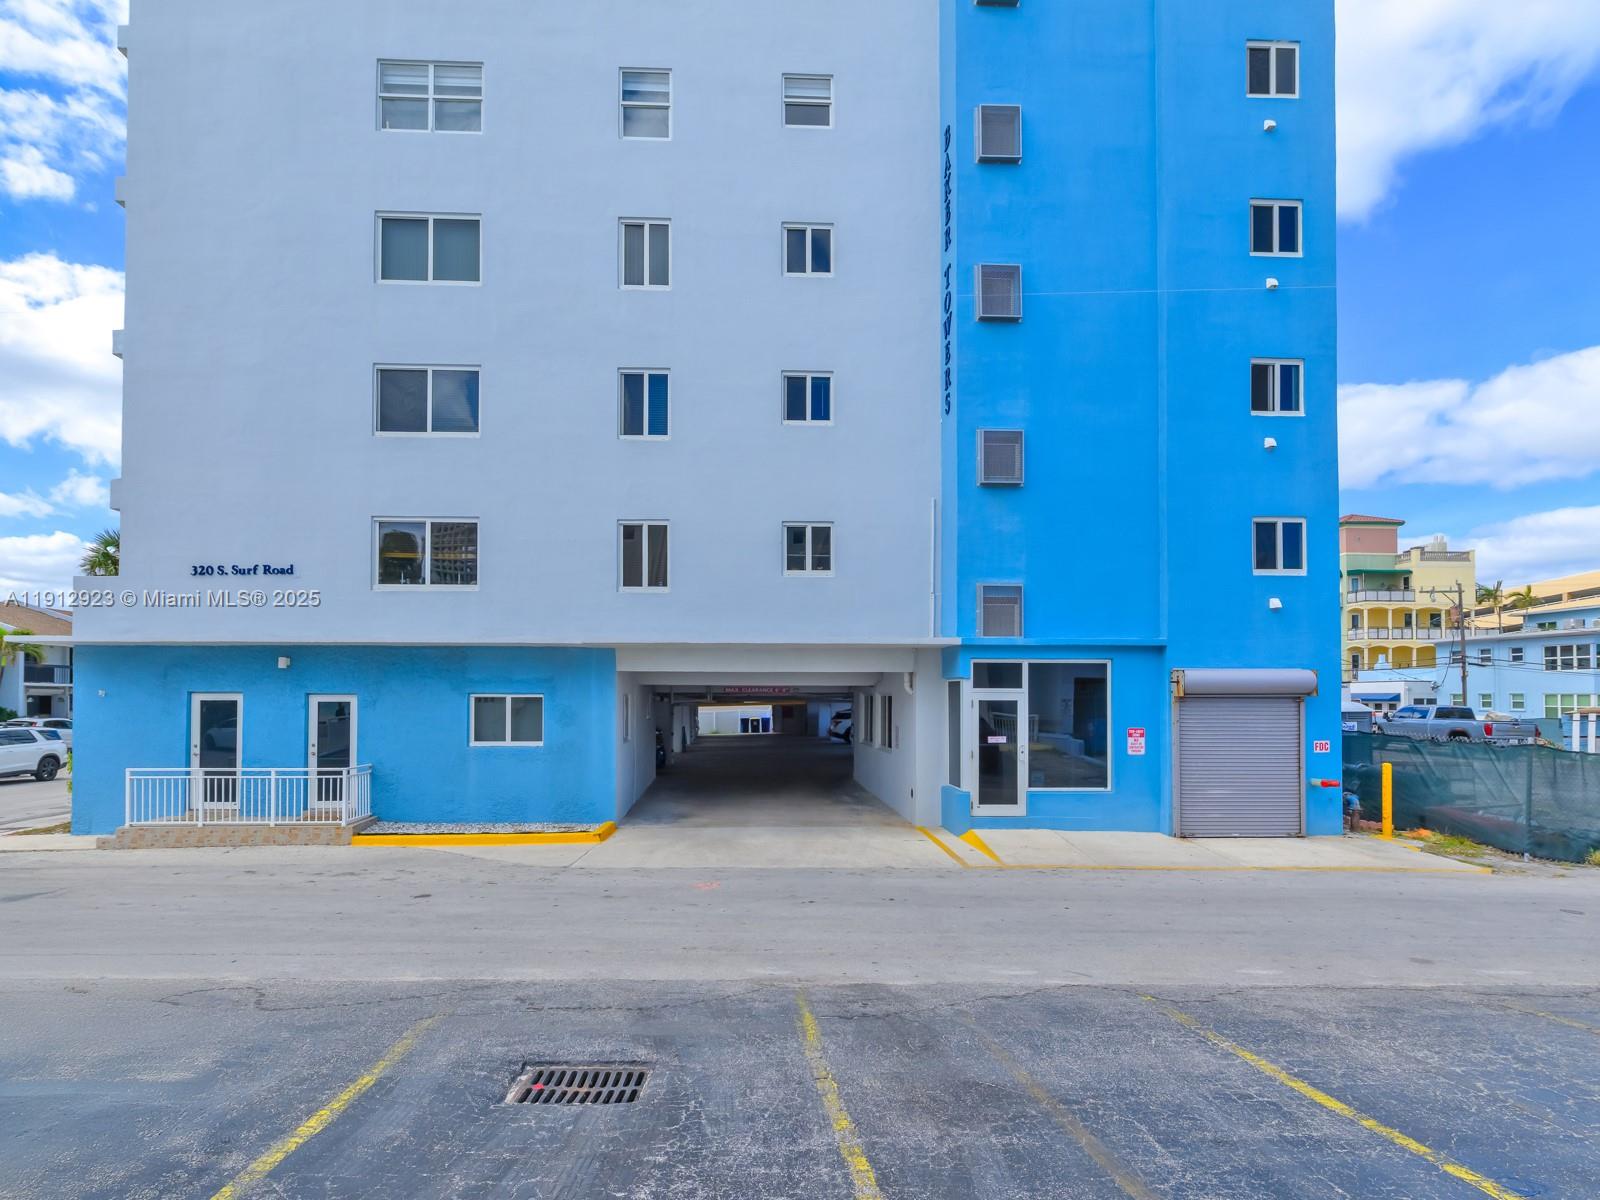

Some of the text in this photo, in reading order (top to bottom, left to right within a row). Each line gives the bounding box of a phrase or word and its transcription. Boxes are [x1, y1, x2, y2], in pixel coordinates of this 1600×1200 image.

[943, 262, 953, 415] TOWERS
[190, 564, 294, 576] 320 S. Surf Road
[1314, 742, 1329, 752] FDC
